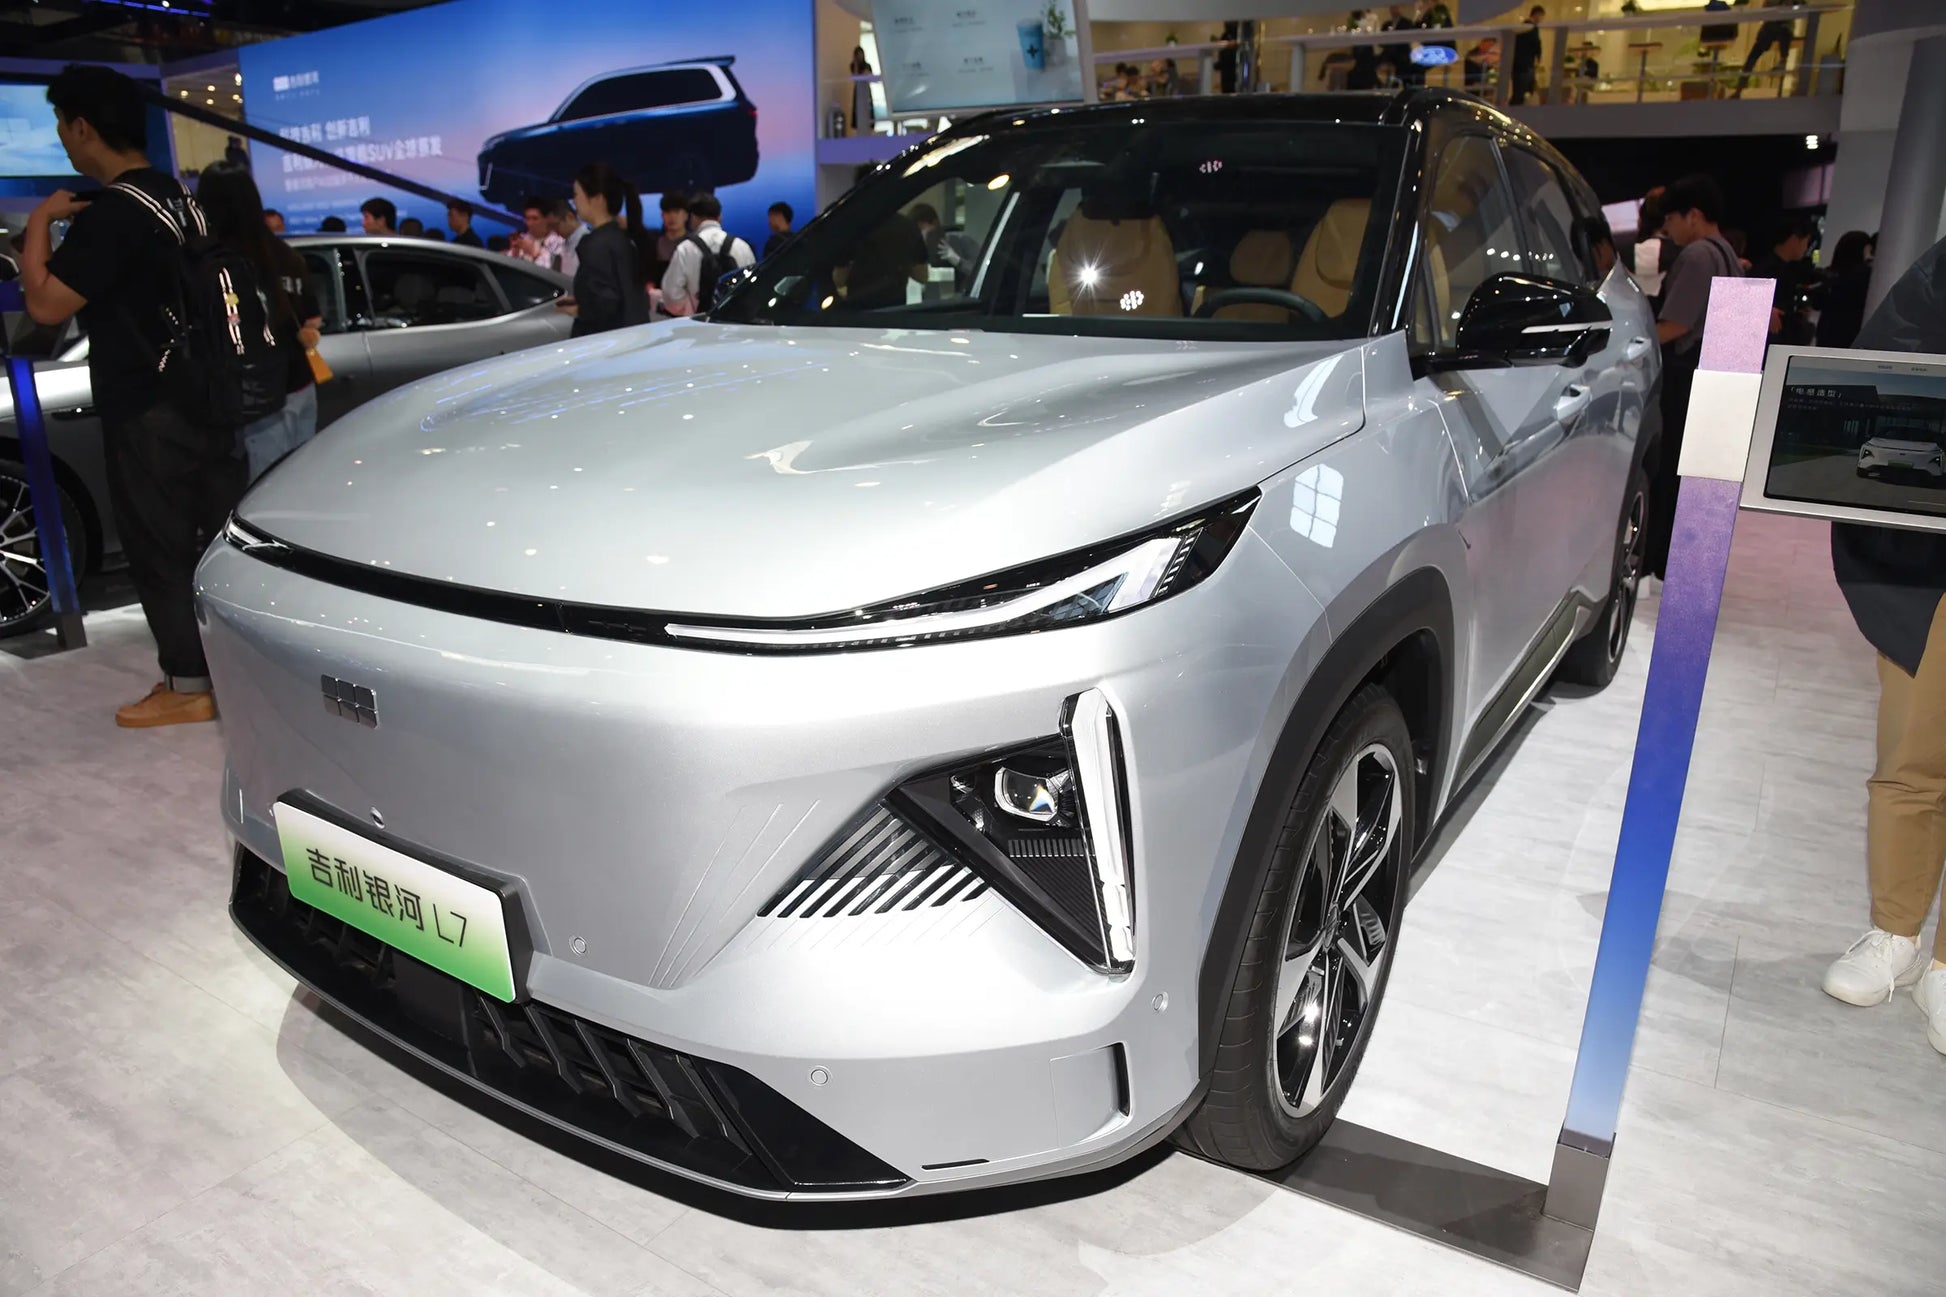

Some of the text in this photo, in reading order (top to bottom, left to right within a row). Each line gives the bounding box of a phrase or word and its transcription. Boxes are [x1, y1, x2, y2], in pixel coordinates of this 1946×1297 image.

[306, 848, 467, 947] 吉利银河 L7
